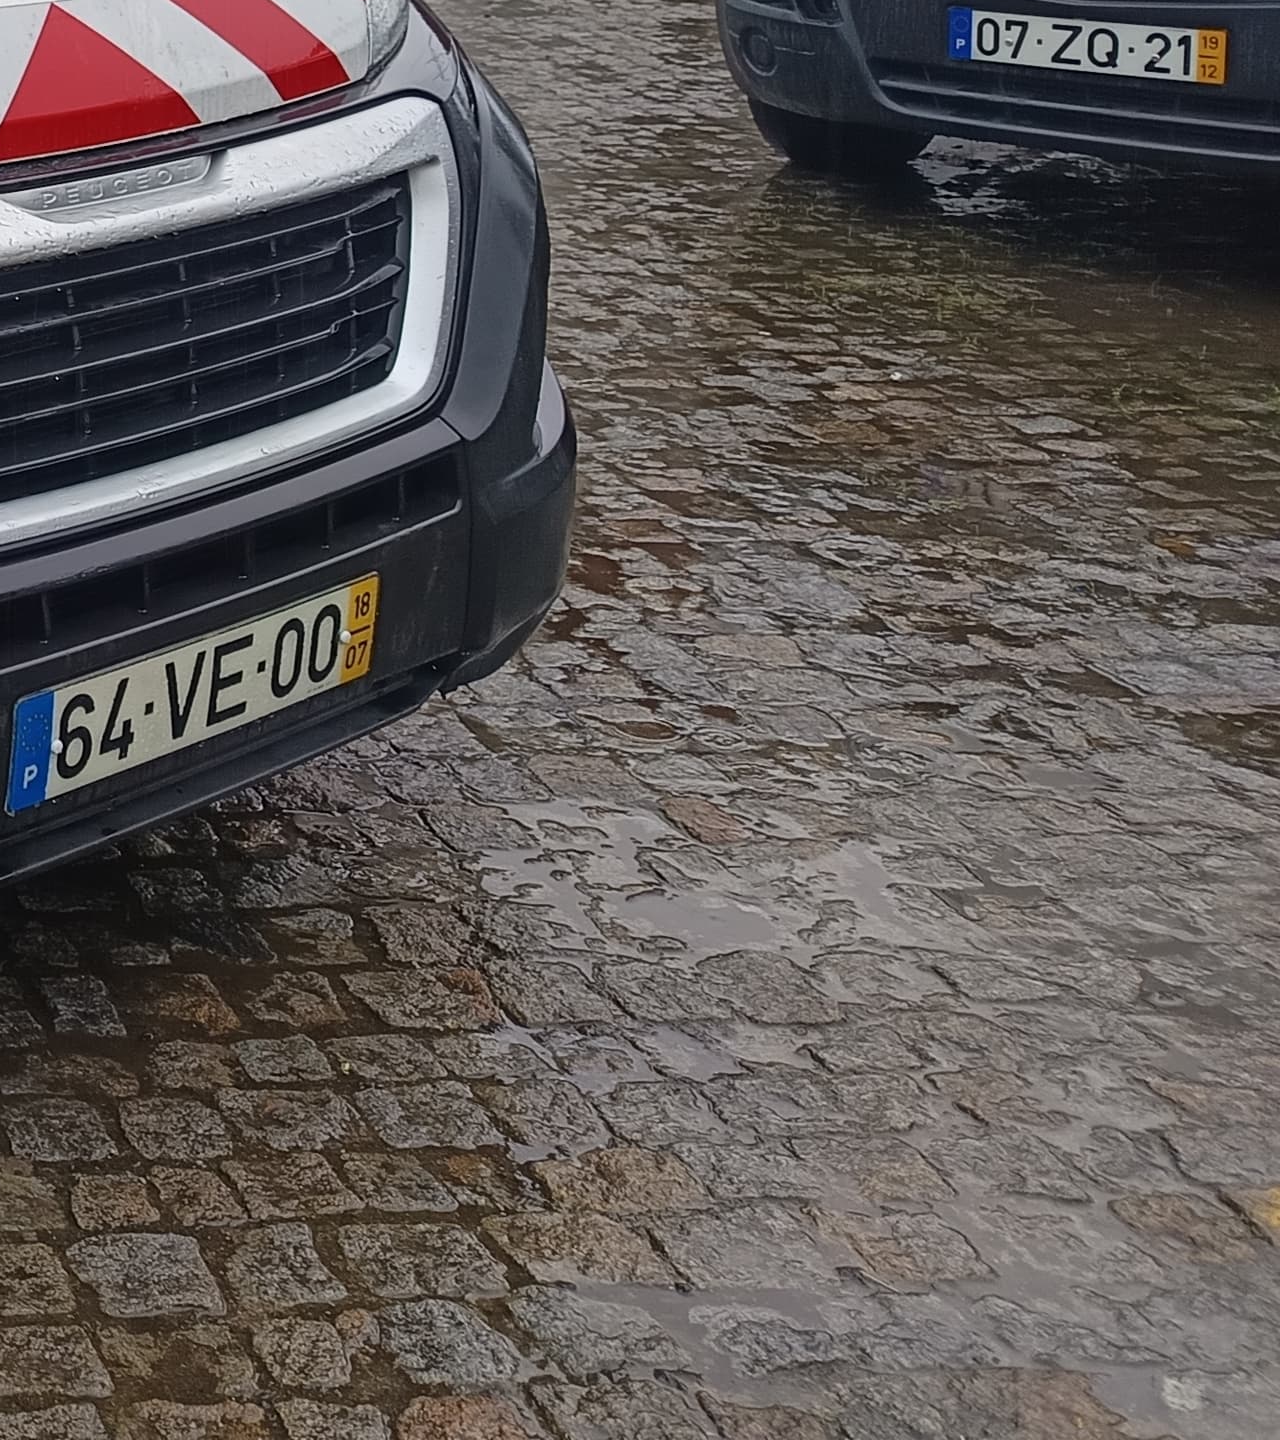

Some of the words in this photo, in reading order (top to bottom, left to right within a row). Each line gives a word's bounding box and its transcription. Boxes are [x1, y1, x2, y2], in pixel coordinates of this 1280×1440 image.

[955, 38, 966, 50] P
[1202, 35, 1219, 50] 19
[1200, 64, 1218, 79] 12
[41, 163, 195, 209] PEUGEOT
[353, 591, 371, 620] 18
[345, 639, 369, 670] 07
[22, 763, 39, 790] P
